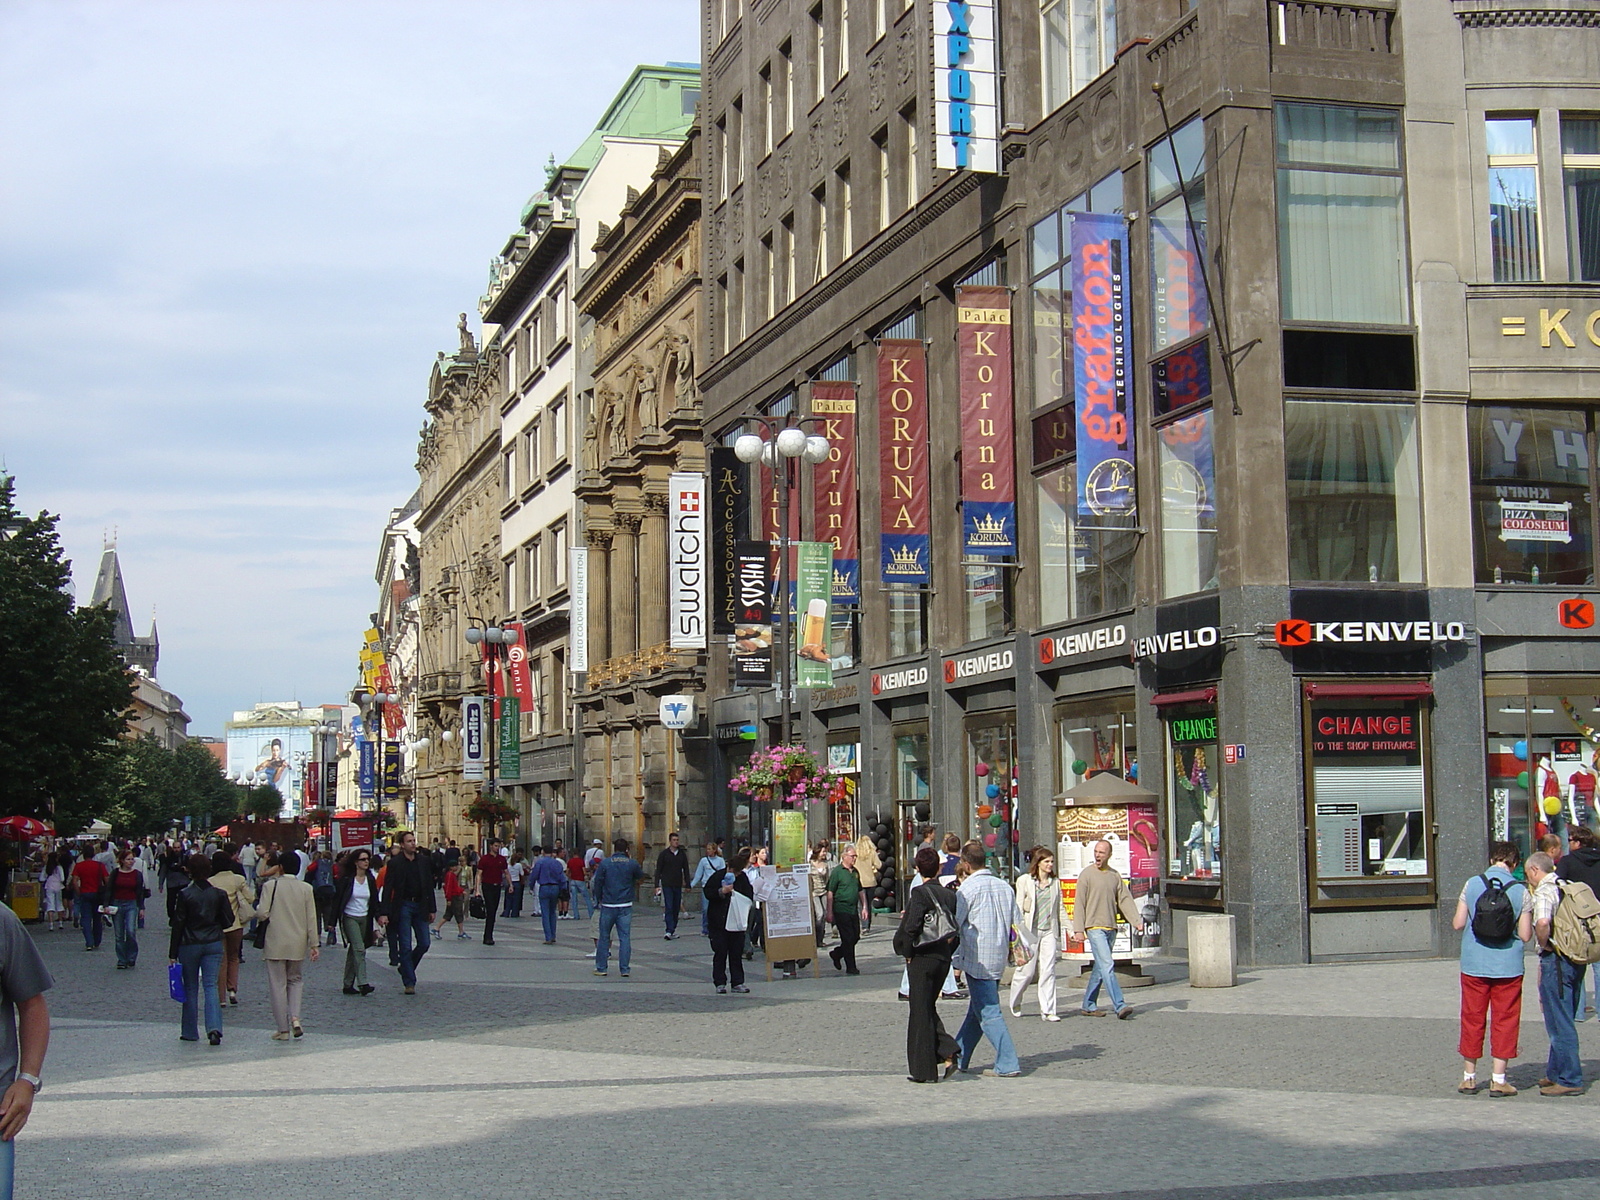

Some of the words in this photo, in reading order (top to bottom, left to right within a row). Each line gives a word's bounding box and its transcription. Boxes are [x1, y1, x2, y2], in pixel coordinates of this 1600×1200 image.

[946, 0, 972, 170] XPORT
[964, 311, 1006, 323] Palác
[1076, 239, 1127, 445] grafton
[1113, 274, 1126, 397] TECHNOLOGIES
[817, 401, 851, 411] Palác
[974, 331, 997, 490] Koruna
[891, 359, 915, 529] KORUNA
[826, 419, 845, 550] Koruna
[1504, 510, 1536, 519] PIZZA
[1504, 520, 1565, 531] COLOSEUM
[970, 533, 1008, 542] KORUNA
[674, 514, 700, 635] swatch
[887, 563, 924, 572] KORUNA
[577, 595, 583, 605] OF
[1564, 603, 1588, 625] K
[1056, 625, 1126, 658] KENVELO
[1133, 626, 1217, 659] KENVELO
[1316, 621, 1464, 642] KENVELO
[957, 650, 1013, 678] KENVELO
[882, 667, 928, 691] KENVELO
[469, 709, 478, 753] Berlitz
[502, 717, 512, 747] Holiday
[1173, 717, 1217, 741] CHANGE
[1318, 716, 1412, 736] CHANGE
[1313, 742, 1324, 751] TO
[1328, 742, 1344, 750] THE
[1347, 741, 1369, 751] SHOP
[1373, 741, 1416, 750] ENTRANCE
